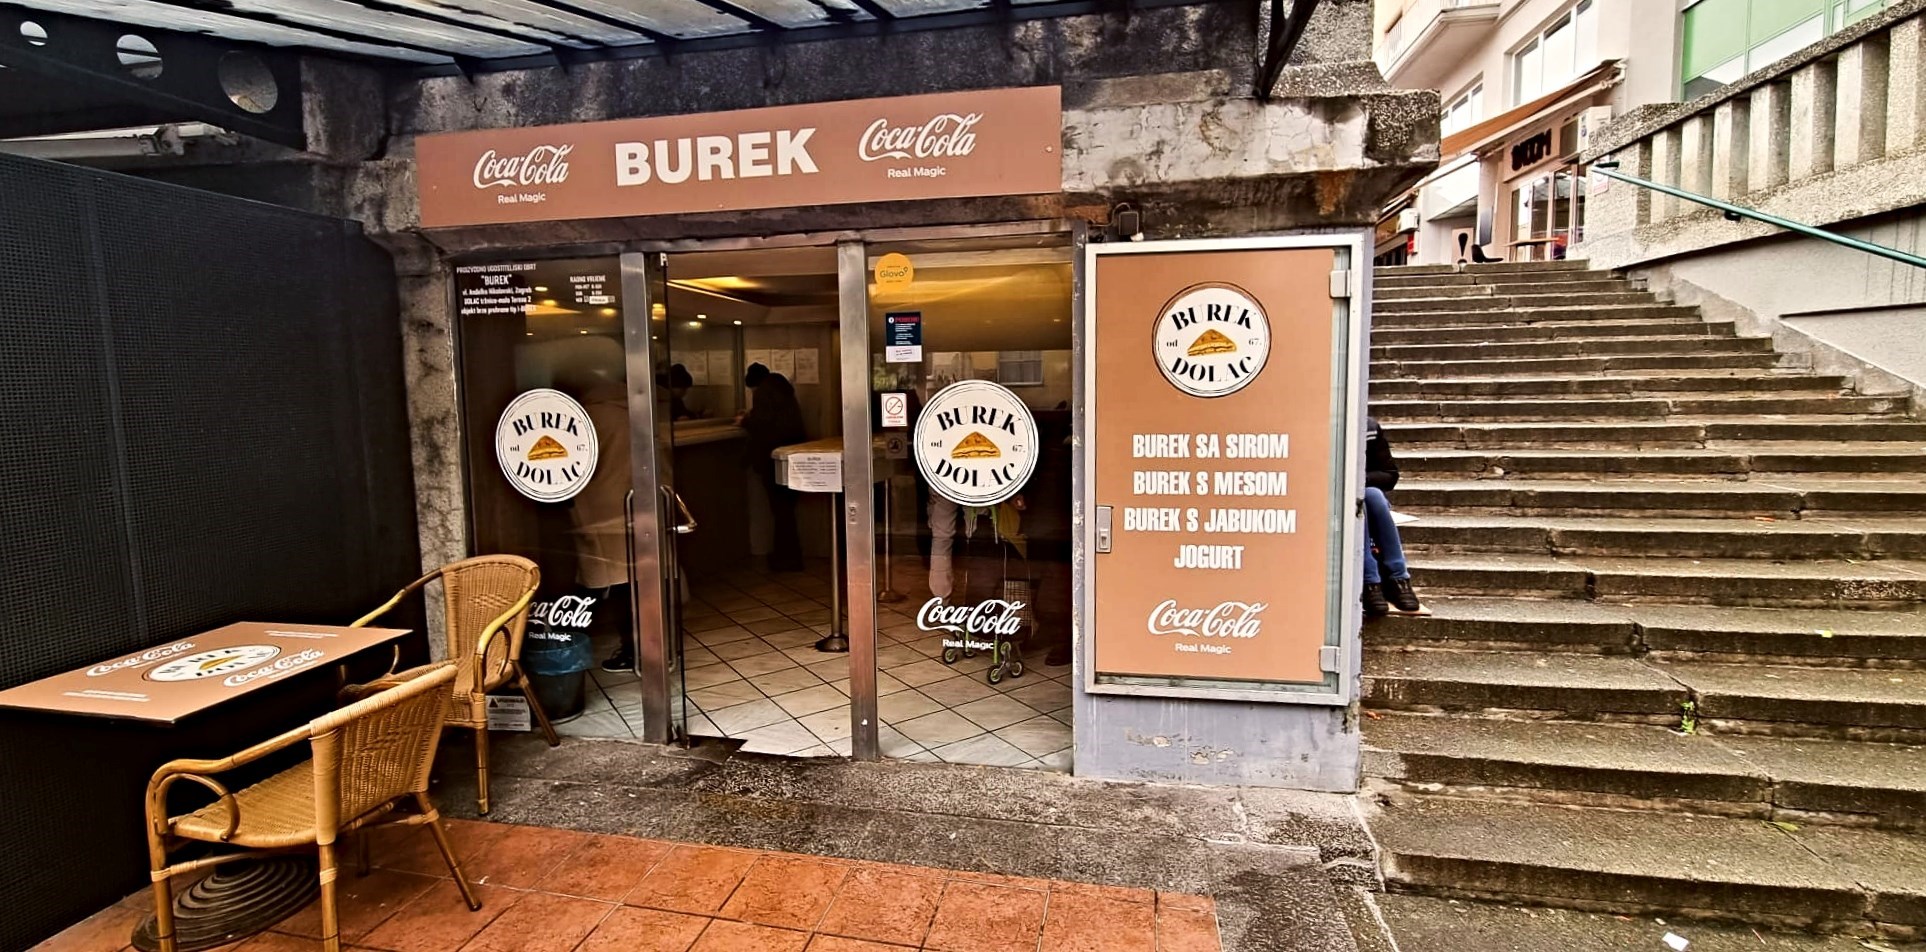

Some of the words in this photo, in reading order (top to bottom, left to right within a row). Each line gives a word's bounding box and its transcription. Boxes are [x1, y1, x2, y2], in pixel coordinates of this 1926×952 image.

[858, 112, 984, 162] Coca-Cola
[473, 144, 574, 189] Coca-Cola
[615, 128, 819, 186] BUREK
[887, 166, 912, 179] Real
[915, 165, 946, 179] Magic
[498, 193, 517, 204] Real
[519, 191, 546, 204] Magic
[880, 267, 908, 278] Glovo
[1172, 304, 1256, 331] BUREK
[1166, 339, 1178, 347] od
[1171, 356, 1252, 382] DOLAC
[512, 412, 580, 436] BUREK
[937, 405, 1022, 436] BUREK
[930, 440, 942, 448] od
[1133, 434, 1190, 458] BUREK
[1196, 434, 1220, 458] SA
[1226, 434, 1289, 459] SIROM
[516, 461, 581, 485] DOLAC
[935, 459, 1015, 487] DOLAC
[1133, 471, 1191, 495] BUREK
[1196, 471, 1209, 495] S
[1214, 472, 1287, 496] MESOM
[1124, 508, 1181, 531] BUREK
[1186, 508, 1198, 532] S
[1204, 509, 1296, 533] JABUKOM
[1174, 545, 1244, 569] JOGURT
[528, 595, 596, 628] ca-Cola
[917, 597, 1026, 635] Coca-Cola
[1148, 599, 1269, 638] Coca-Cola
[528, 632, 546, 640] Real
[548, 633, 572, 642] Magic
[942, 639, 964, 648] Real
[965, 640, 994, 650] Magic
[1175, 643, 1198, 653] Real
[1200, 643, 1231, 654] Magic
